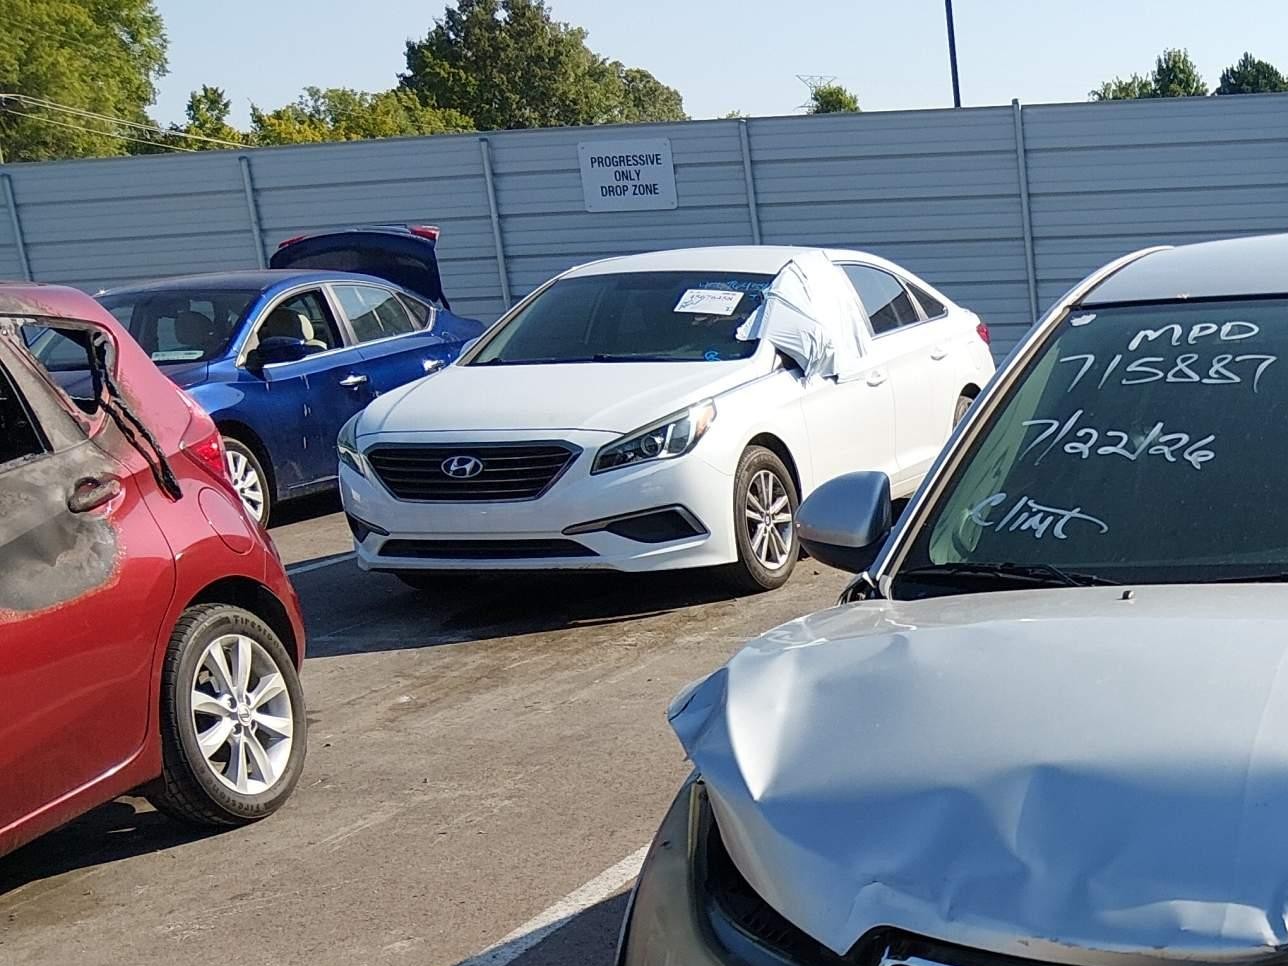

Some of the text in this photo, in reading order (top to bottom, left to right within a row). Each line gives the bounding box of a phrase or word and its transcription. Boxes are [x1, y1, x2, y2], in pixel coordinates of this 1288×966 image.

[590, 153, 663, 168] PROGRESSIVE
[614, 169, 641, 182] ONLY
[600, 184, 660, 197] DROP ZONE
[1128, 321, 1260, 351] MPD
[1059, 353, 1278, 393] 715887
[1018, 408, 1216, 470] 7/22/26
